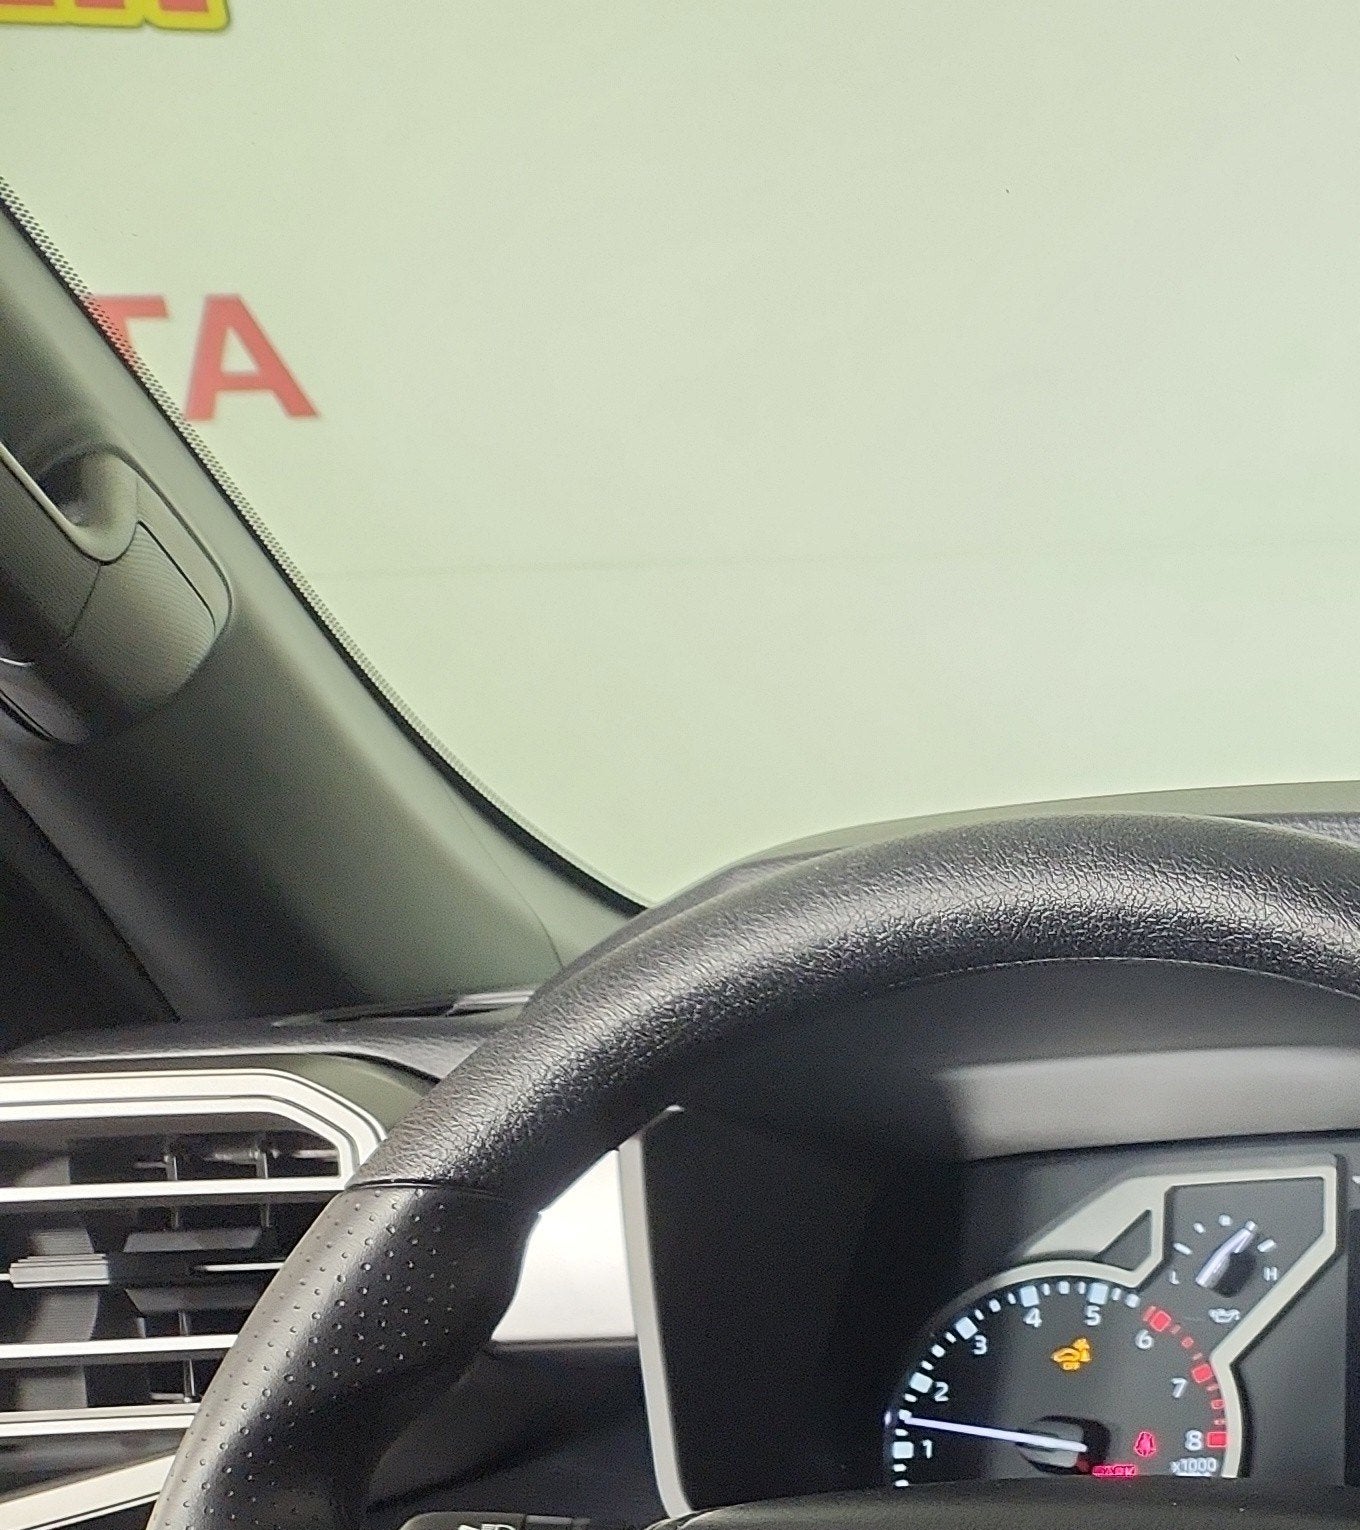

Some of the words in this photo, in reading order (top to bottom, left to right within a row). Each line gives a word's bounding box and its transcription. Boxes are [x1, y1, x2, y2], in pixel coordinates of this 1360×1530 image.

[1168, 1270, 1180, 1285] L
[1263, 1266, 1278, 1281] H
[1023, 1307, 1042, 1328] 4
[1085, 1305, 1101, 1327] 5
[972, 1334, 988, 1355] 3
[1134, 1329, 1154, 1350] 6
[934, 1381, 949, 1402] 2
[1170, 1377, 1188, 1398] 7
[921, 1439, 934, 1459] 1
[1184, 1429, 1204, 1451] 8
